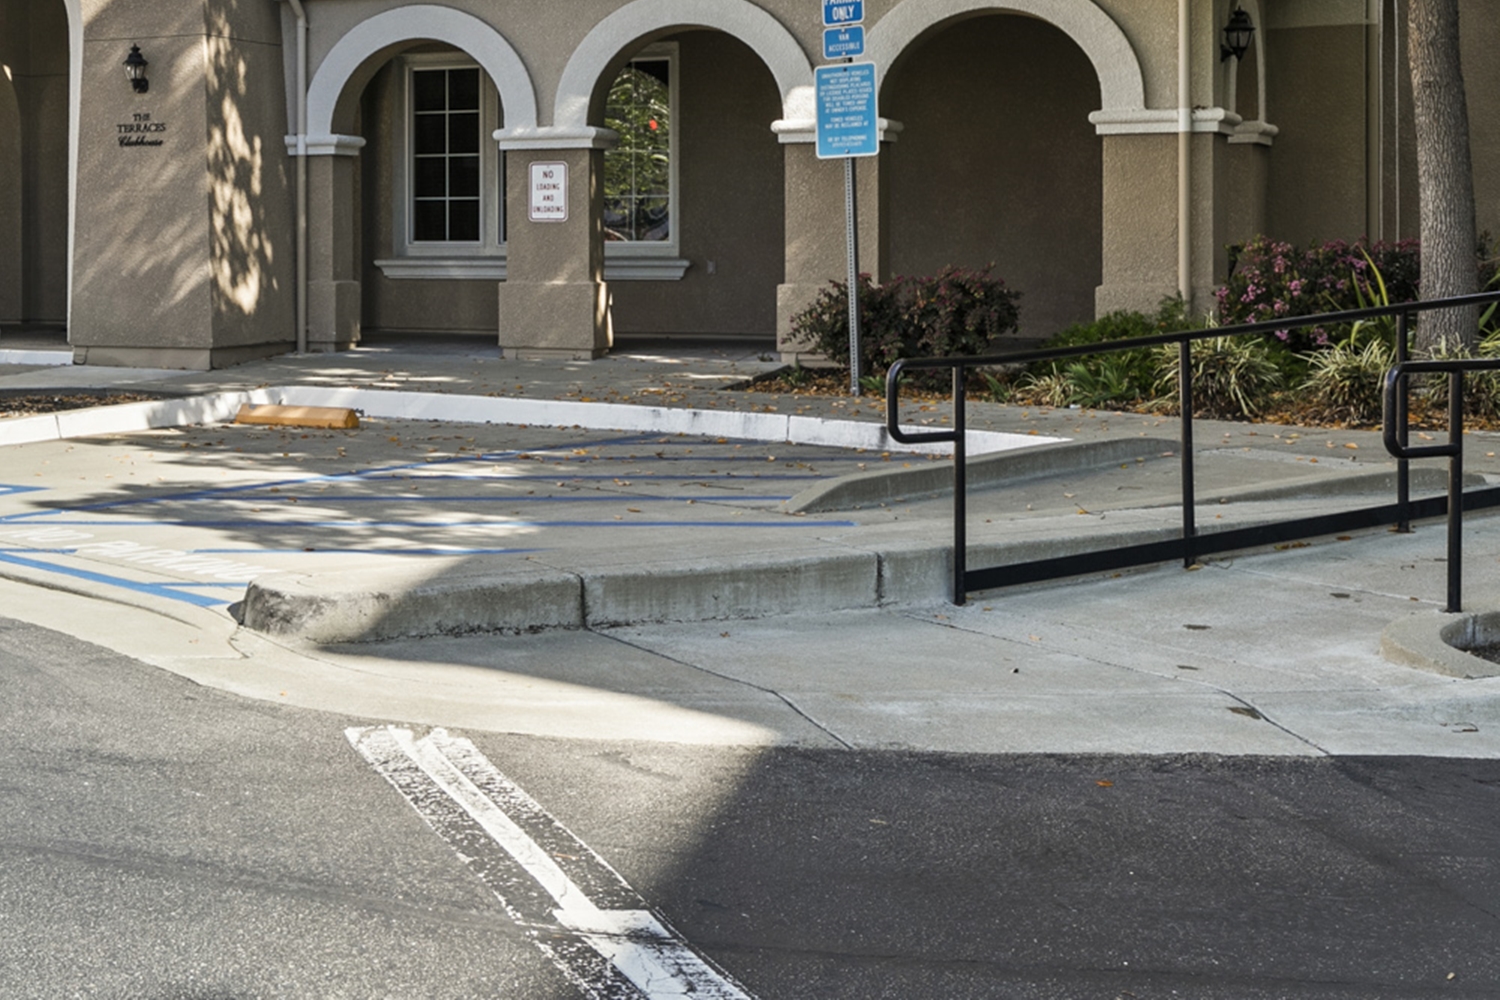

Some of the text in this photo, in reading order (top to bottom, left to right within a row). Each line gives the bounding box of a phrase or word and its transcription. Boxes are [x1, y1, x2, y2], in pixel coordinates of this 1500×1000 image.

[832, 5, 855, 21] ONLY
[838, 33, 850, 41] VAN
[828, 41, 860, 53] ACCESSIBLE
[133, 113, 150, 121] THE
[116, 122, 166, 133] TERRACES
[542, 170, 554, 179] NO
[536, 183, 560, 191] LOADING
[542, 194, 554, 202] AND
[533, 205, 564, 213] UNLOADING
[0, 527, 282, 580] NO PARKING
